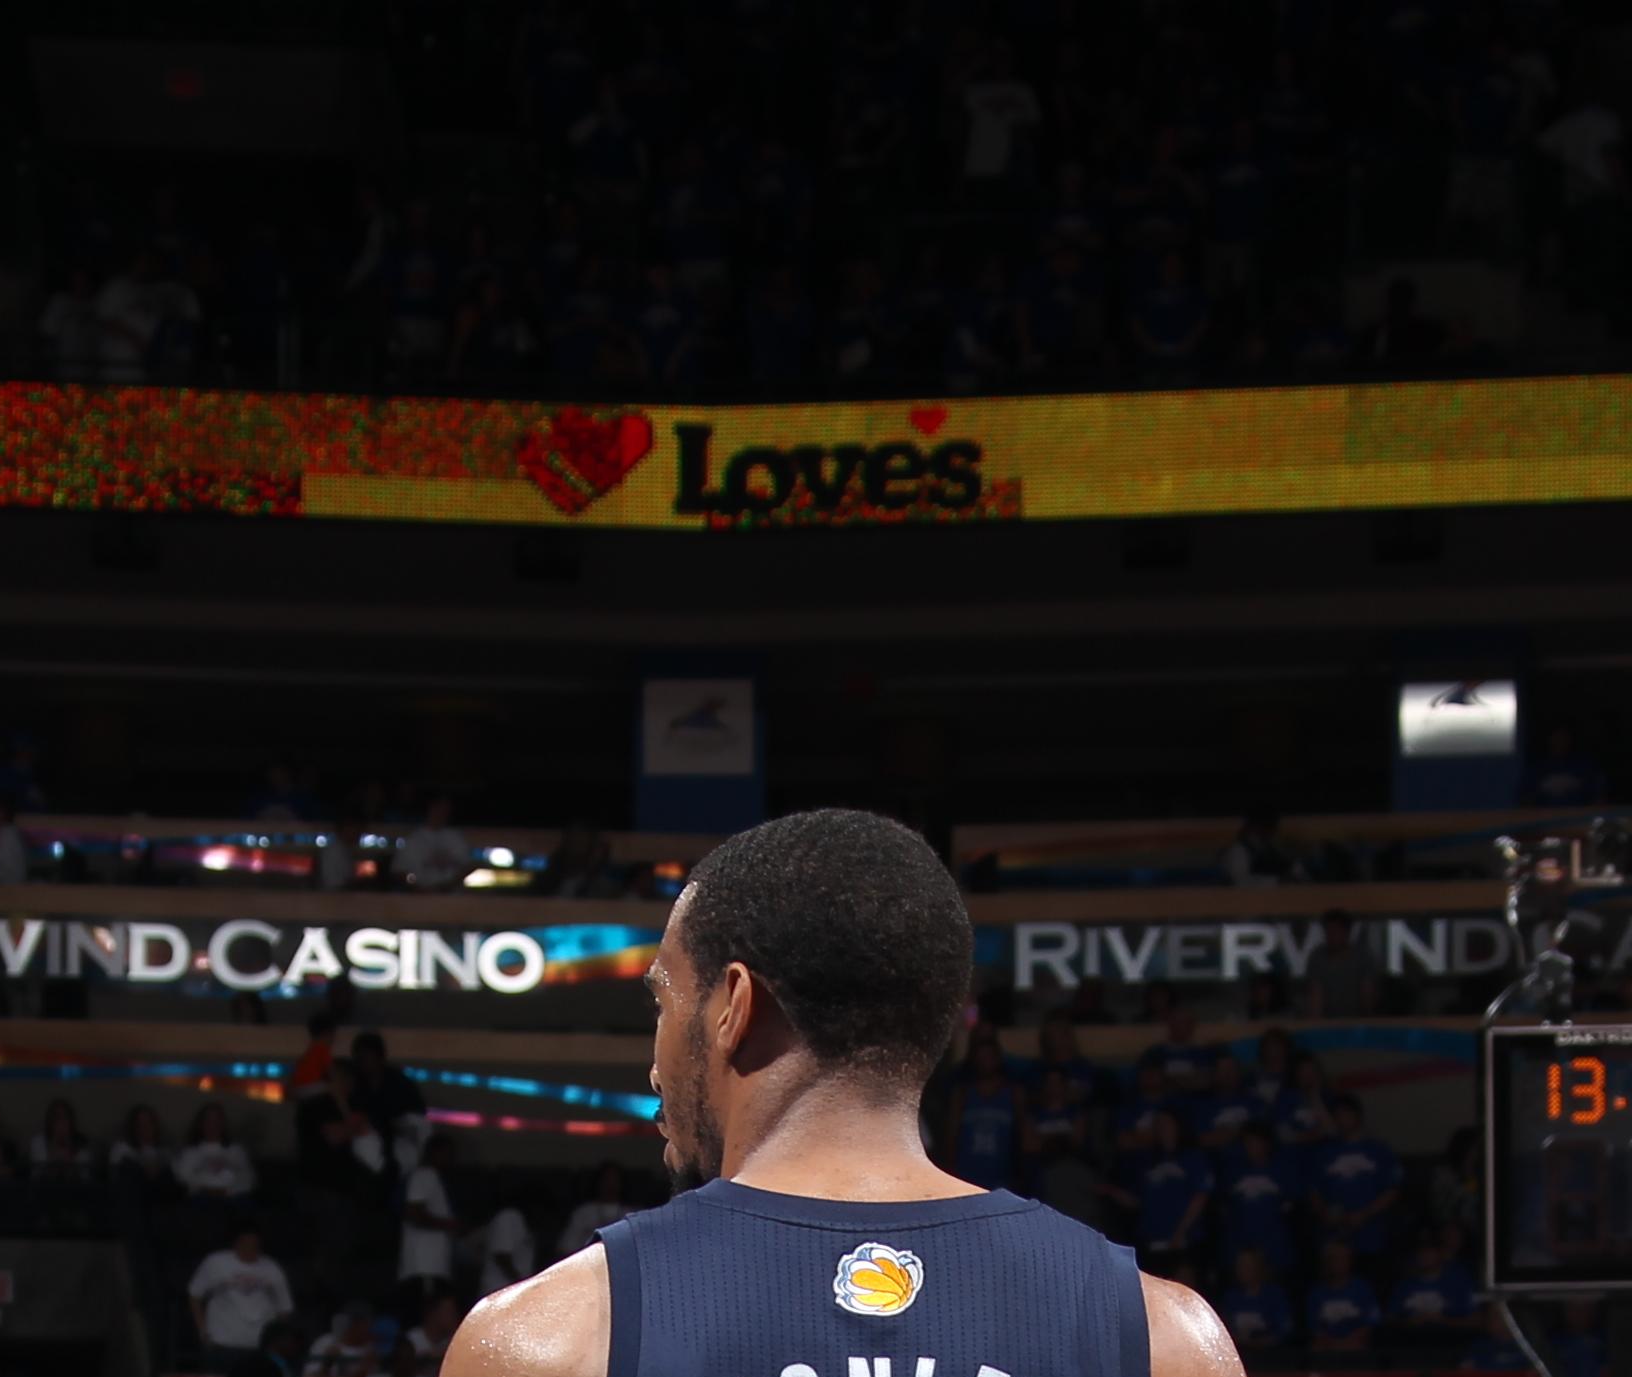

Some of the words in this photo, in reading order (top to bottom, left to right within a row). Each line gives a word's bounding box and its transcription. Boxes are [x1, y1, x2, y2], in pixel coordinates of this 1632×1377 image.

[675, 424, 983, 516] Loves
[207, 917, 546, 994] CASINO
[1014, 917, 1511, 990] RIVERWND
